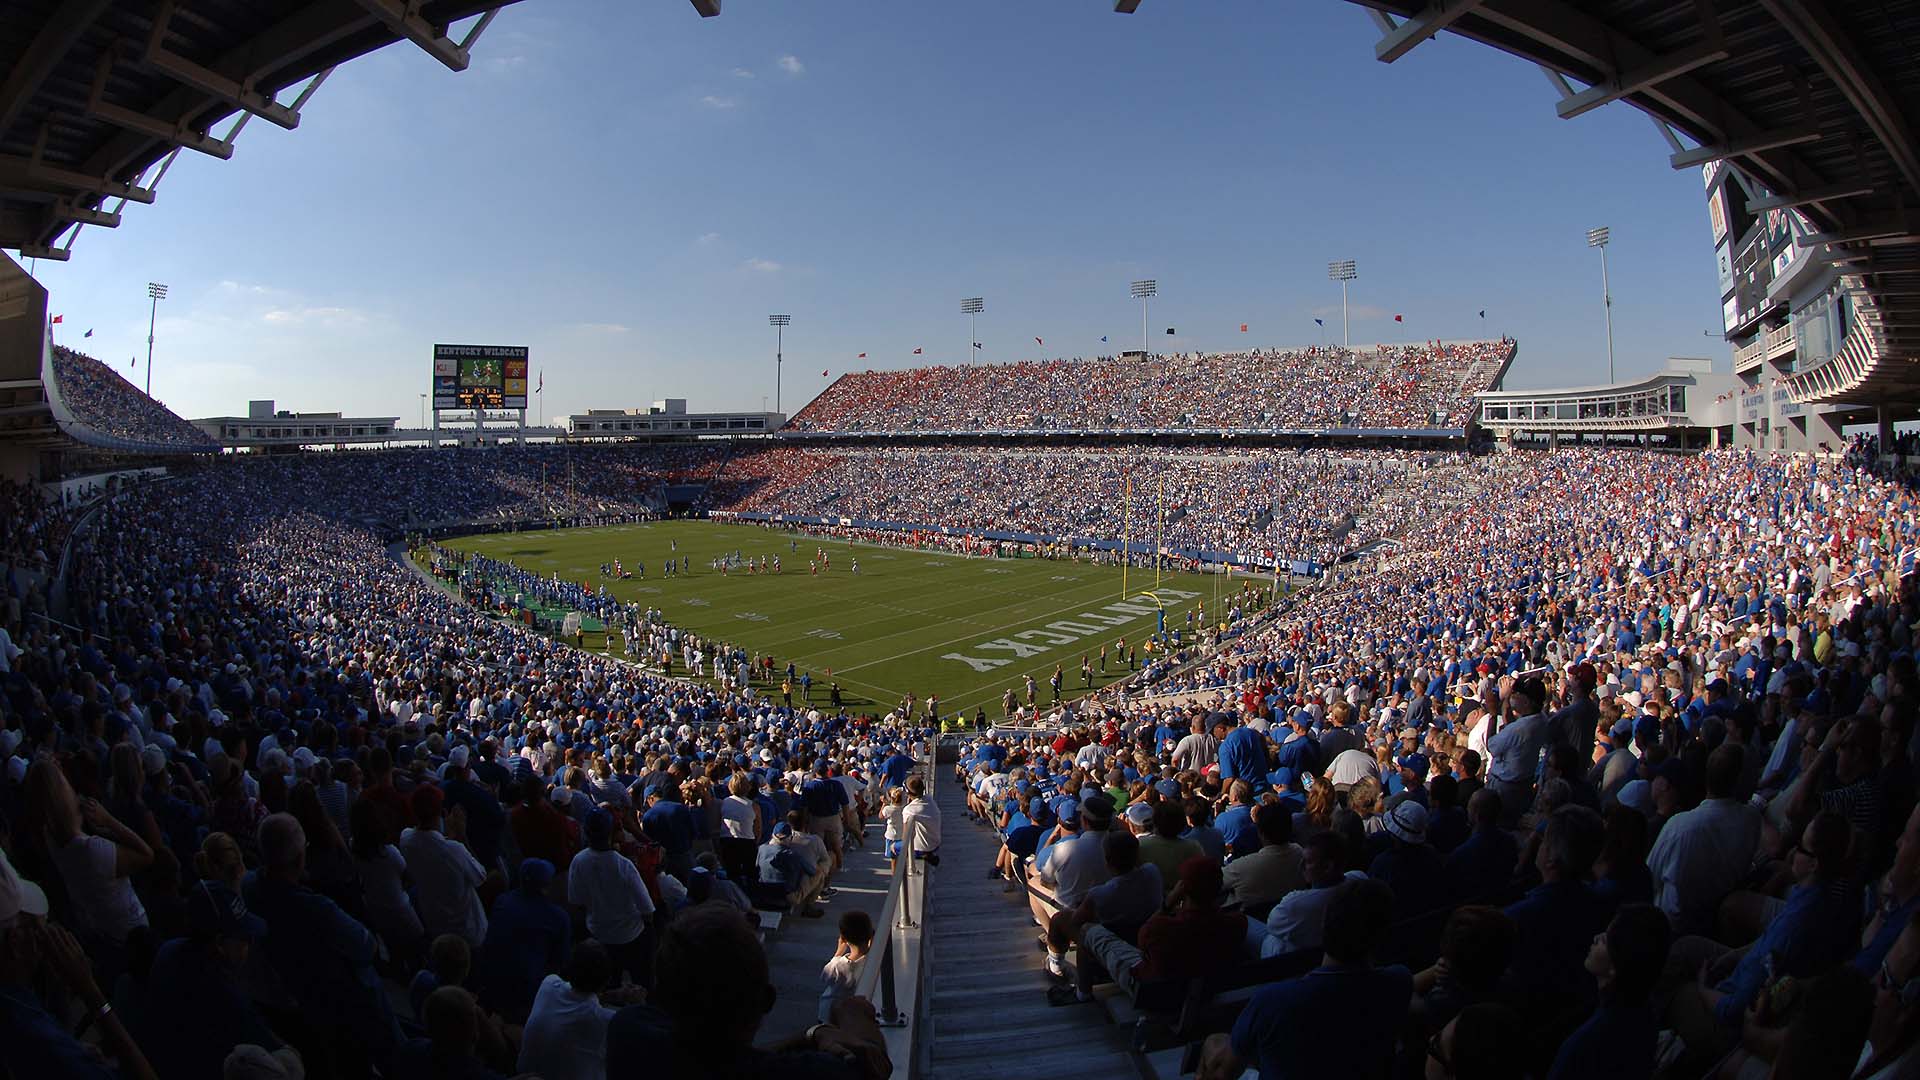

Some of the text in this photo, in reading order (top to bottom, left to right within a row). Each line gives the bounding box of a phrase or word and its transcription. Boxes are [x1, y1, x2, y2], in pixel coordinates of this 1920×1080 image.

[437, 346, 526, 357] KENTUCKY WILDCATS
[1236, 554, 1293, 569] WILDCATS
[940, 588, 1203, 673] KENTUCKY
